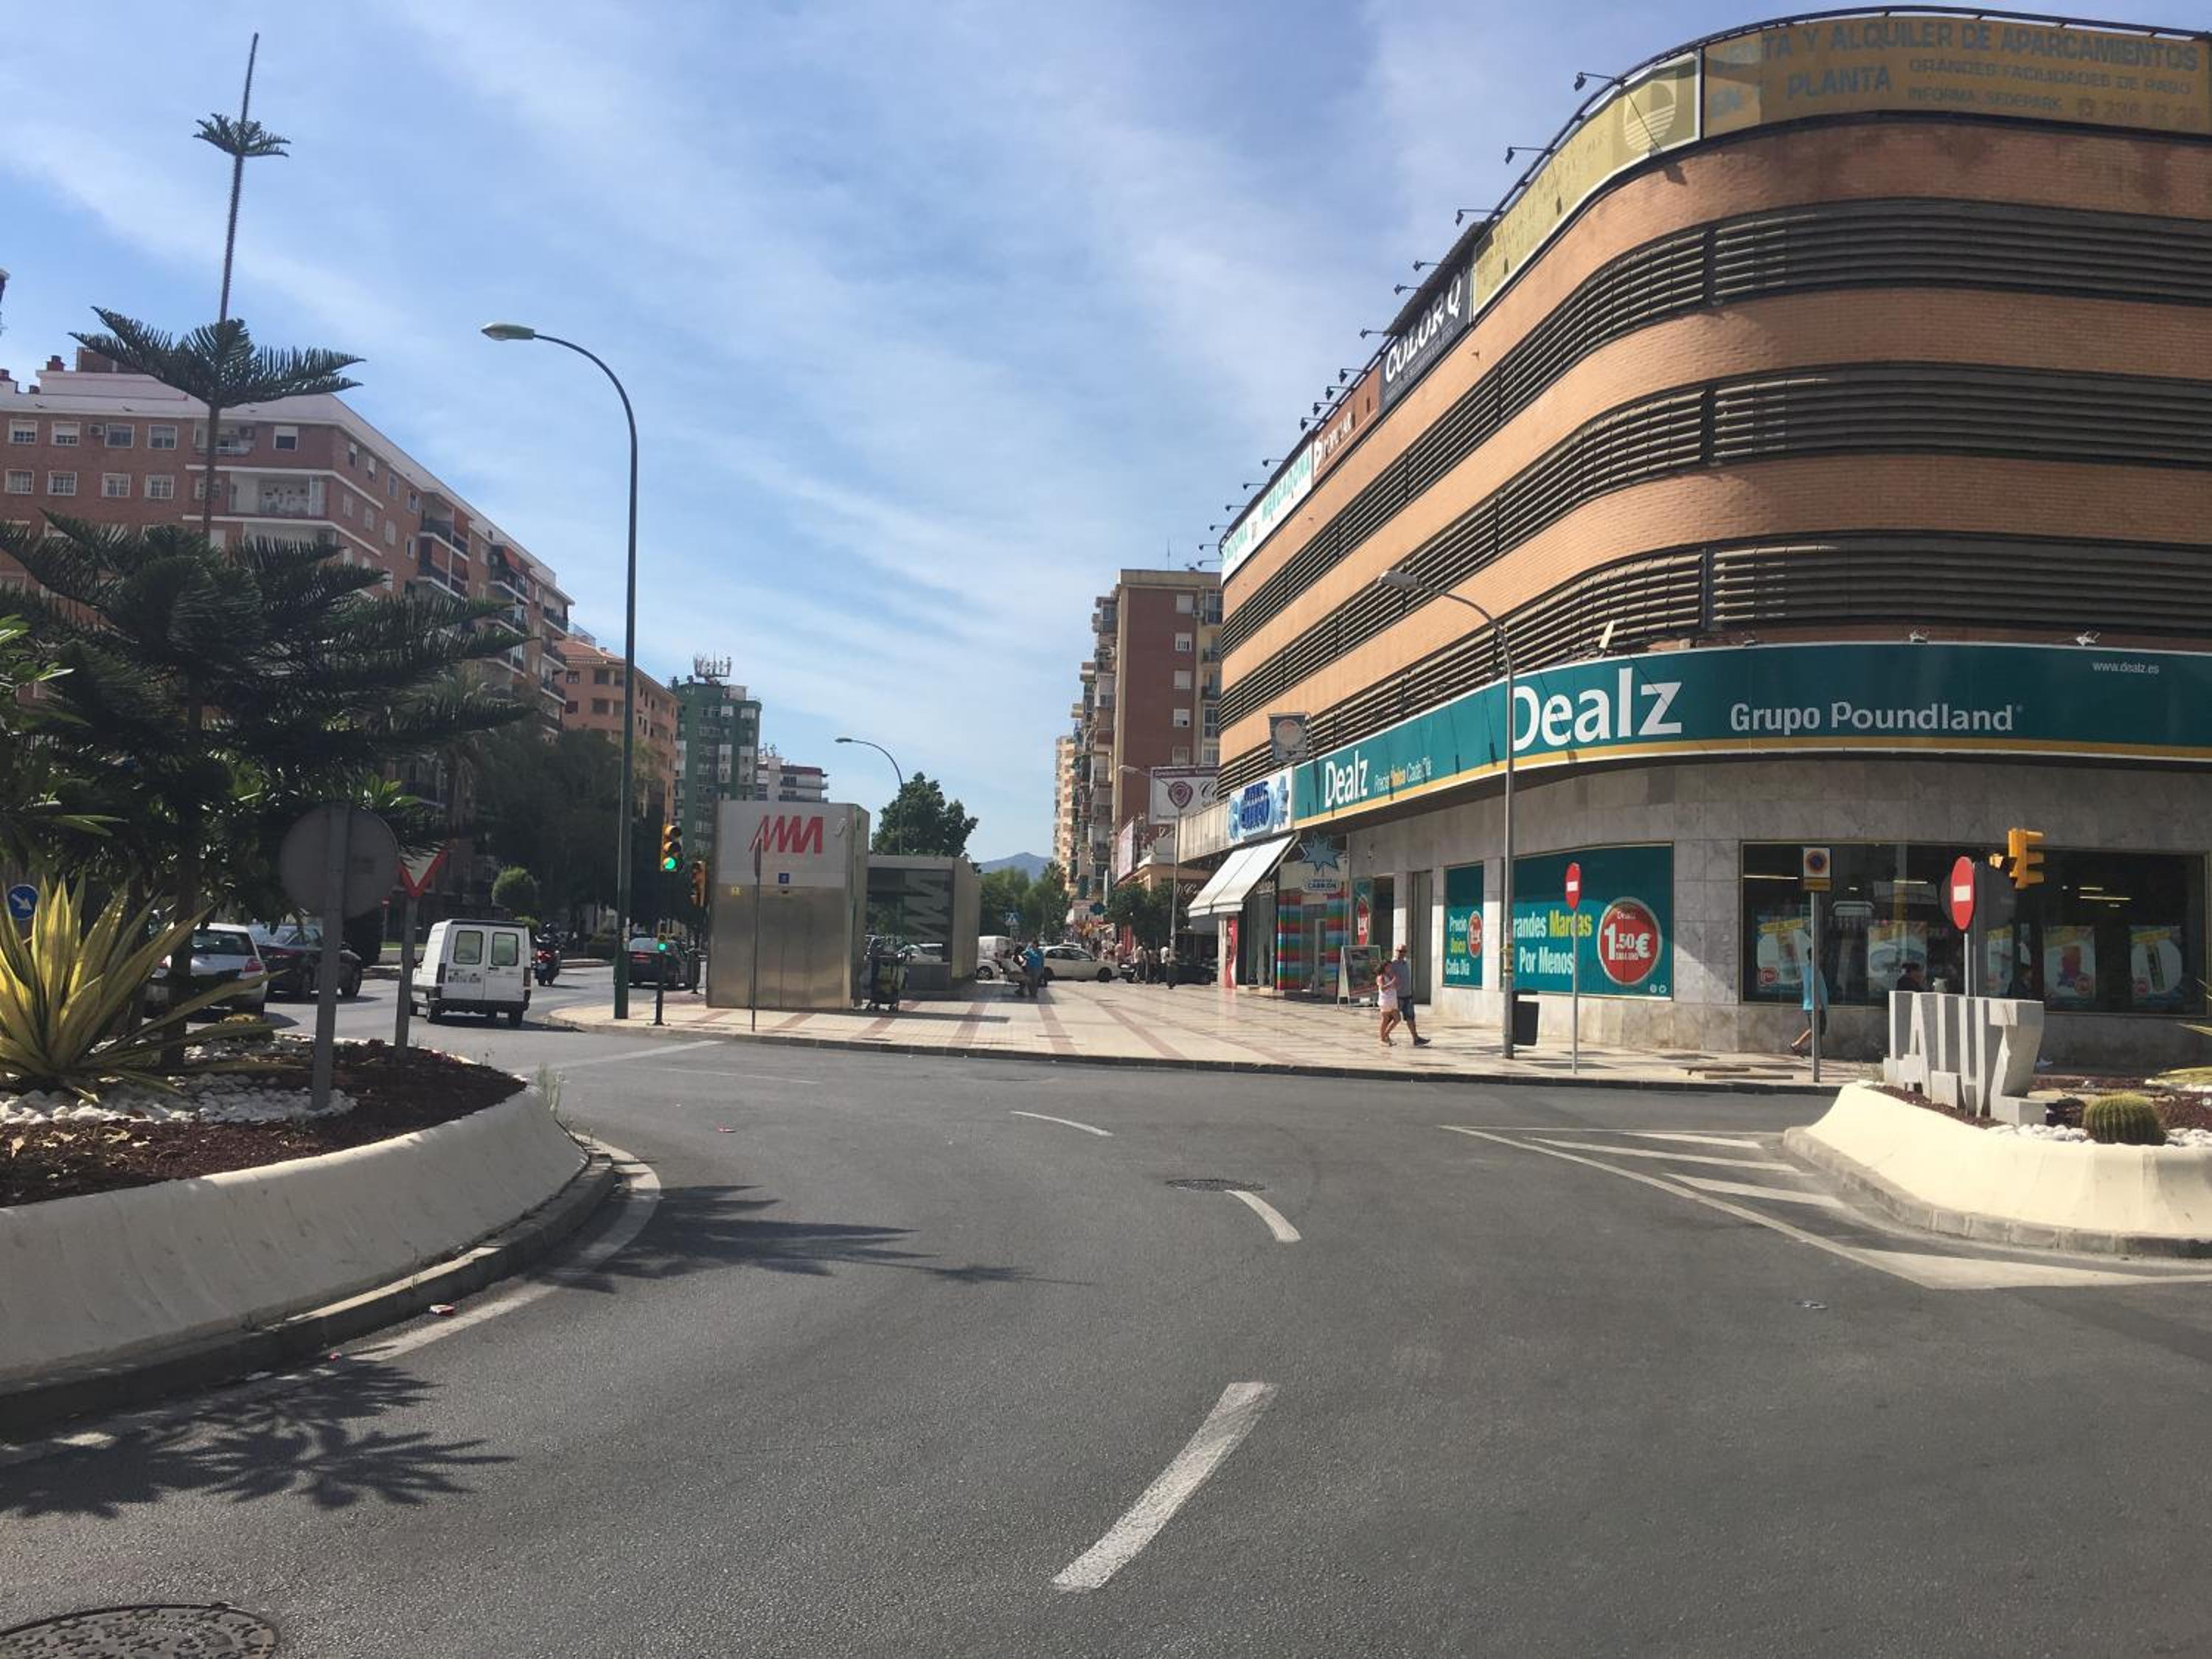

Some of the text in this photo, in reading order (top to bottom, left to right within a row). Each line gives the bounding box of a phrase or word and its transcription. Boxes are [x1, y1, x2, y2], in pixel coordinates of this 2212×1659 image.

[1832, 22, 1953, 50] ALQUILER
[1961, 23, 1991, 50] DE
[2000, 27, 2199, 72] APARCAMIENTOS
[1787, 66, 1892, 99] PLANTA
[1447, 273, 1461, 319] Q
[2092, 661, 2160, 674] www.dealz.es
[1512, 667, 1683, 752] Dealz
[1730, 703, 1820, 736] Grupo
[1324, 748, 1369, 808] Dealz
[1513, 911, 1546, 939] randes
[1520, 946, 1574, 975] Por Menos
